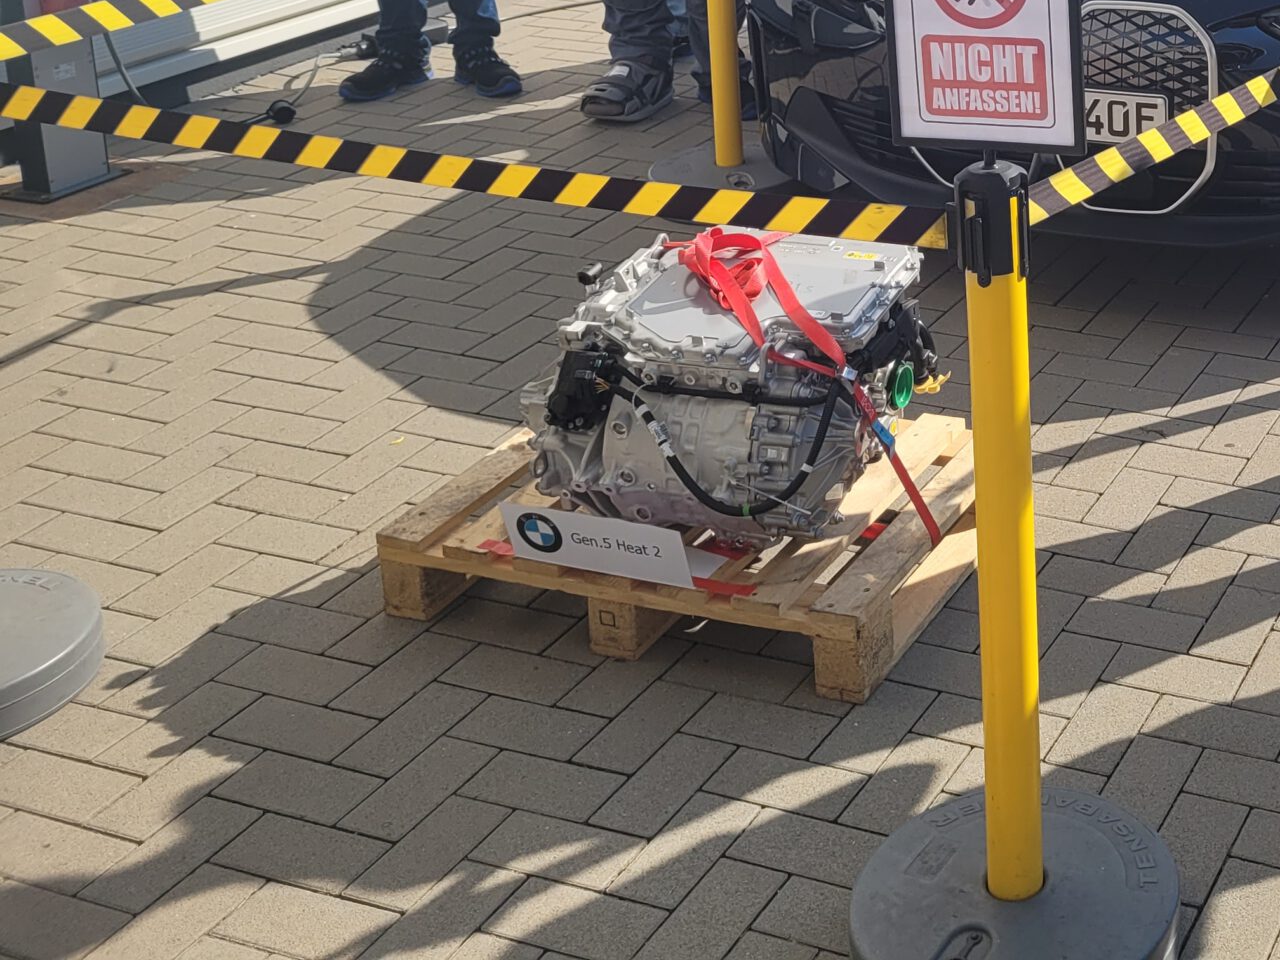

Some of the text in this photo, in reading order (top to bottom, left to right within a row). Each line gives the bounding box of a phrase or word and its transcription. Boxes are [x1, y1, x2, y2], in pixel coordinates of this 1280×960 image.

[929, 42, 1038, 85] NICHT
[932, 87, 1041, 114] ANFASSEN!
[570, 532, 662, 558] Gen.5 Heat 2
